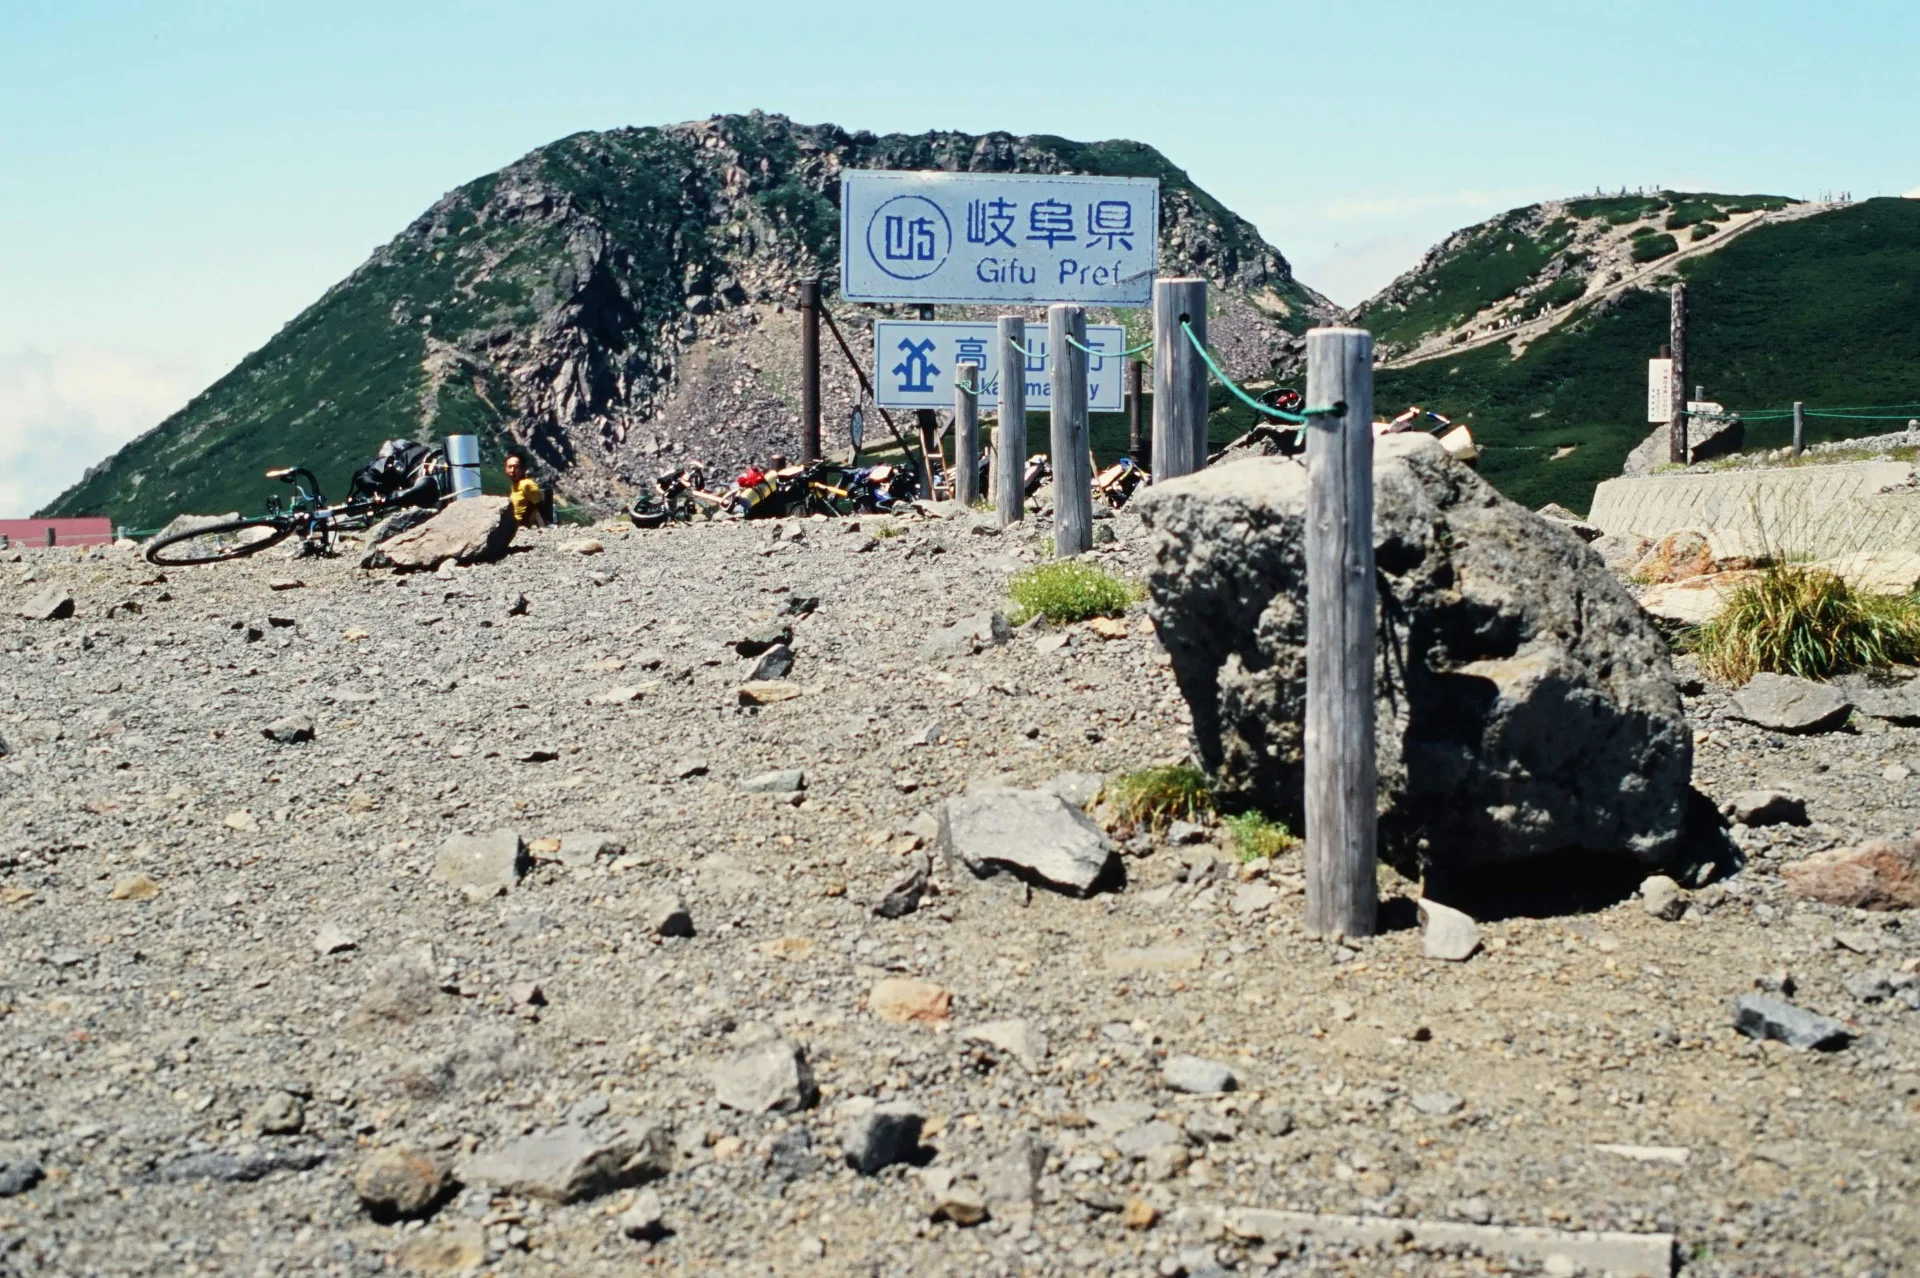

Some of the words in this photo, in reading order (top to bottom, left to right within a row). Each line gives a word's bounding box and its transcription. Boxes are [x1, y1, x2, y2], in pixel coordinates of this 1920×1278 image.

[967, 197, 1134, 250] 岐阜県
[976, 257, 1036, 284] Gifu
